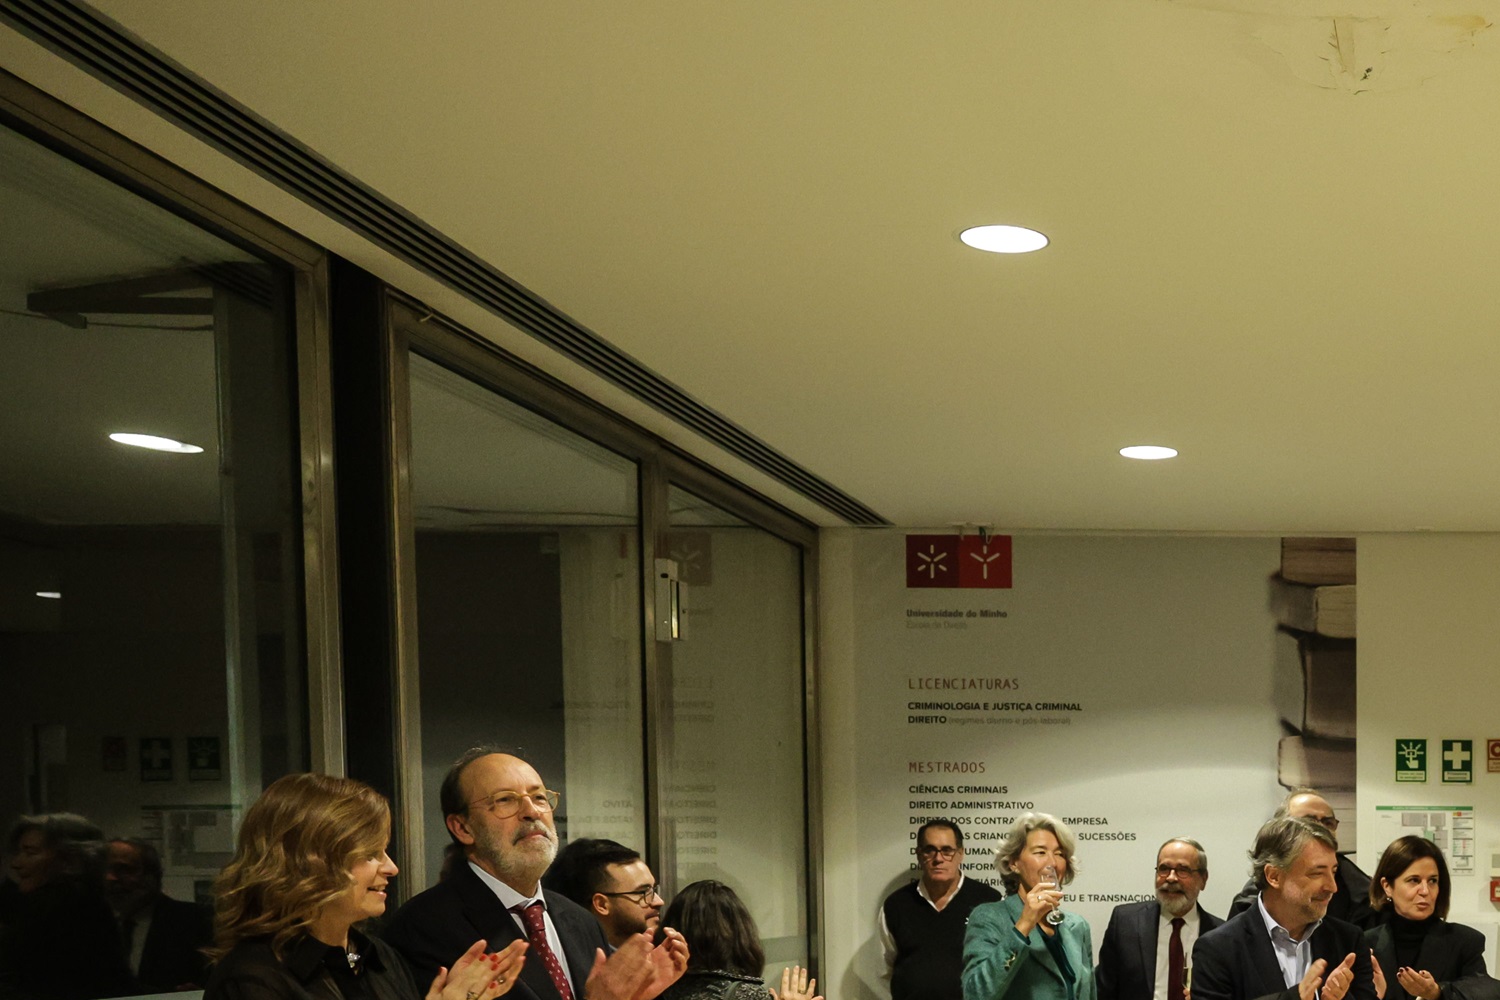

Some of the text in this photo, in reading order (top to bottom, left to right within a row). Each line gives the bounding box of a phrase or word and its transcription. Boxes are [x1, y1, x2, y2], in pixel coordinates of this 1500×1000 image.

[906, 609, 1008, 619] Universidade do Minho
[908, 678, 1020, 691] LICENCIATURAS
[908, 702, 1083, 713] CRIMINOLOGIA E JUSTIÇA CRIMINAL
[908, 715, 947, 724] DIREITO
[908, 762, 986, 774] MESTRADOS
[908, 784, 1008, 794] CIÊNCIAS CRIMINAIS
[909, 801, 1034, 810] DIREITO ADMINISTRATIVO
[951, 817, 972, 825] DOS
[974, 817, 1017, 825] CONTRA
[1062, 817, 1109, 826] EMPRESA
[1078, 831, 1137, 841] SUCESSÕES
[1079, 894, 1085, 902] E
[1088, 894, 1157, 903] TRANSNACION
